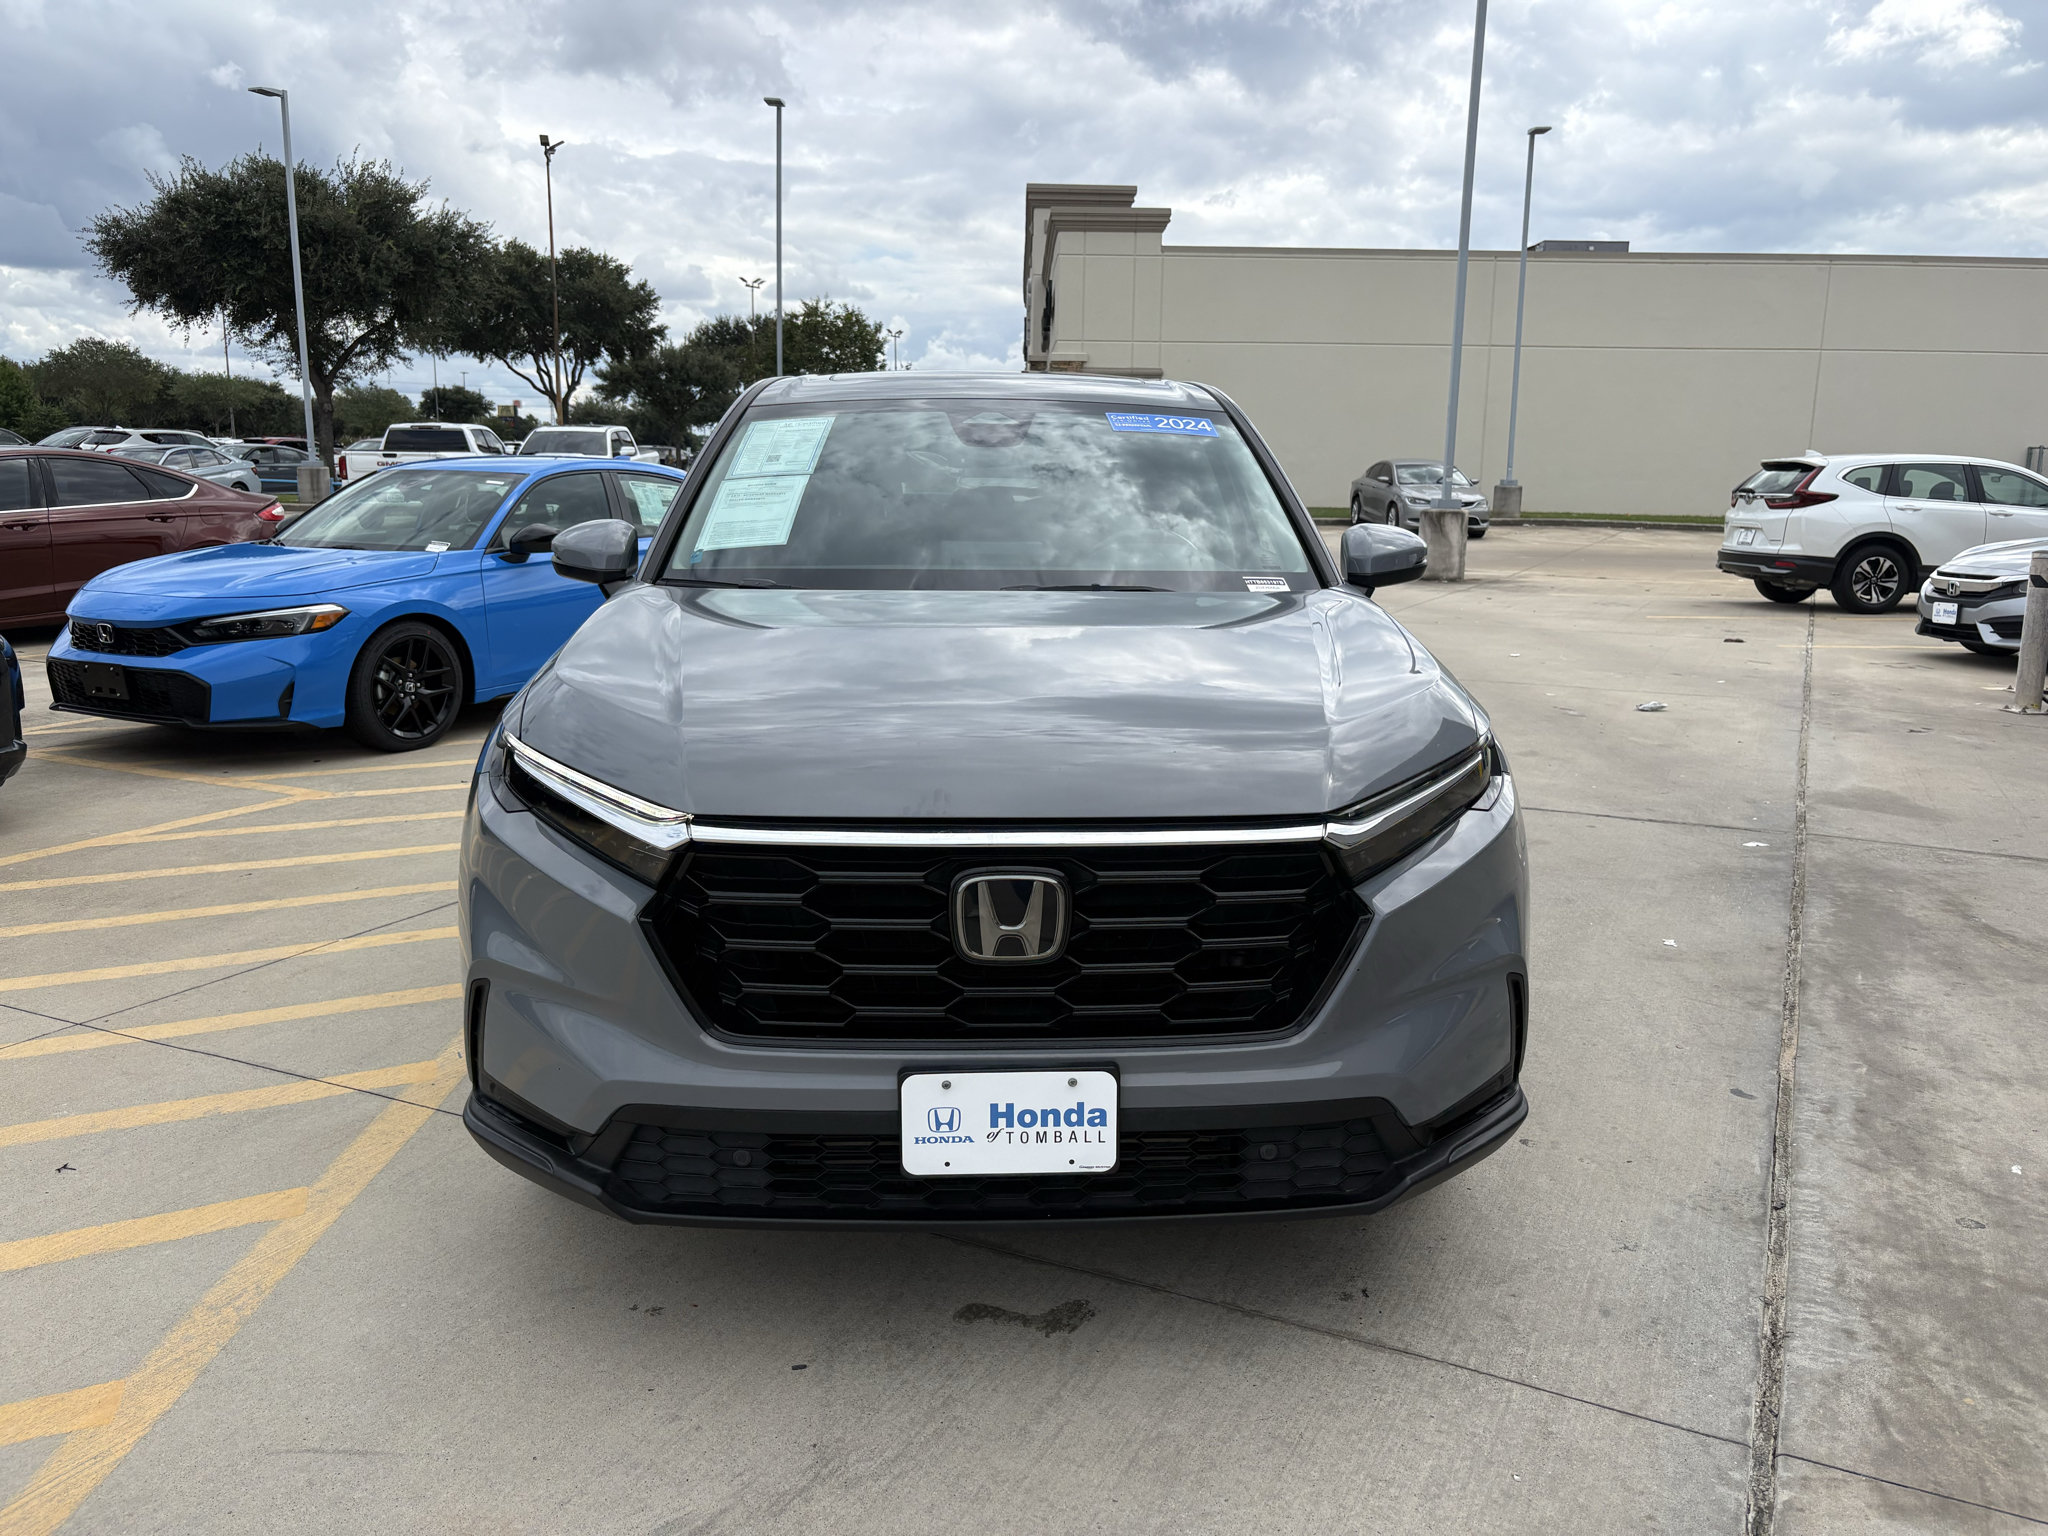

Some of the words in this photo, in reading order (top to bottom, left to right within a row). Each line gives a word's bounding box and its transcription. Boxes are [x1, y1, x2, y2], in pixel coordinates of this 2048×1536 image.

[1154, 417, 1212, 432] 2024
[989, 1102, 1107, 1129] Honda
[914, 1135, 975, 1145] HONDA
[986, 1128, 1004, 1143] of
[1006, 1130, 1106, 1144] TOMBALL
